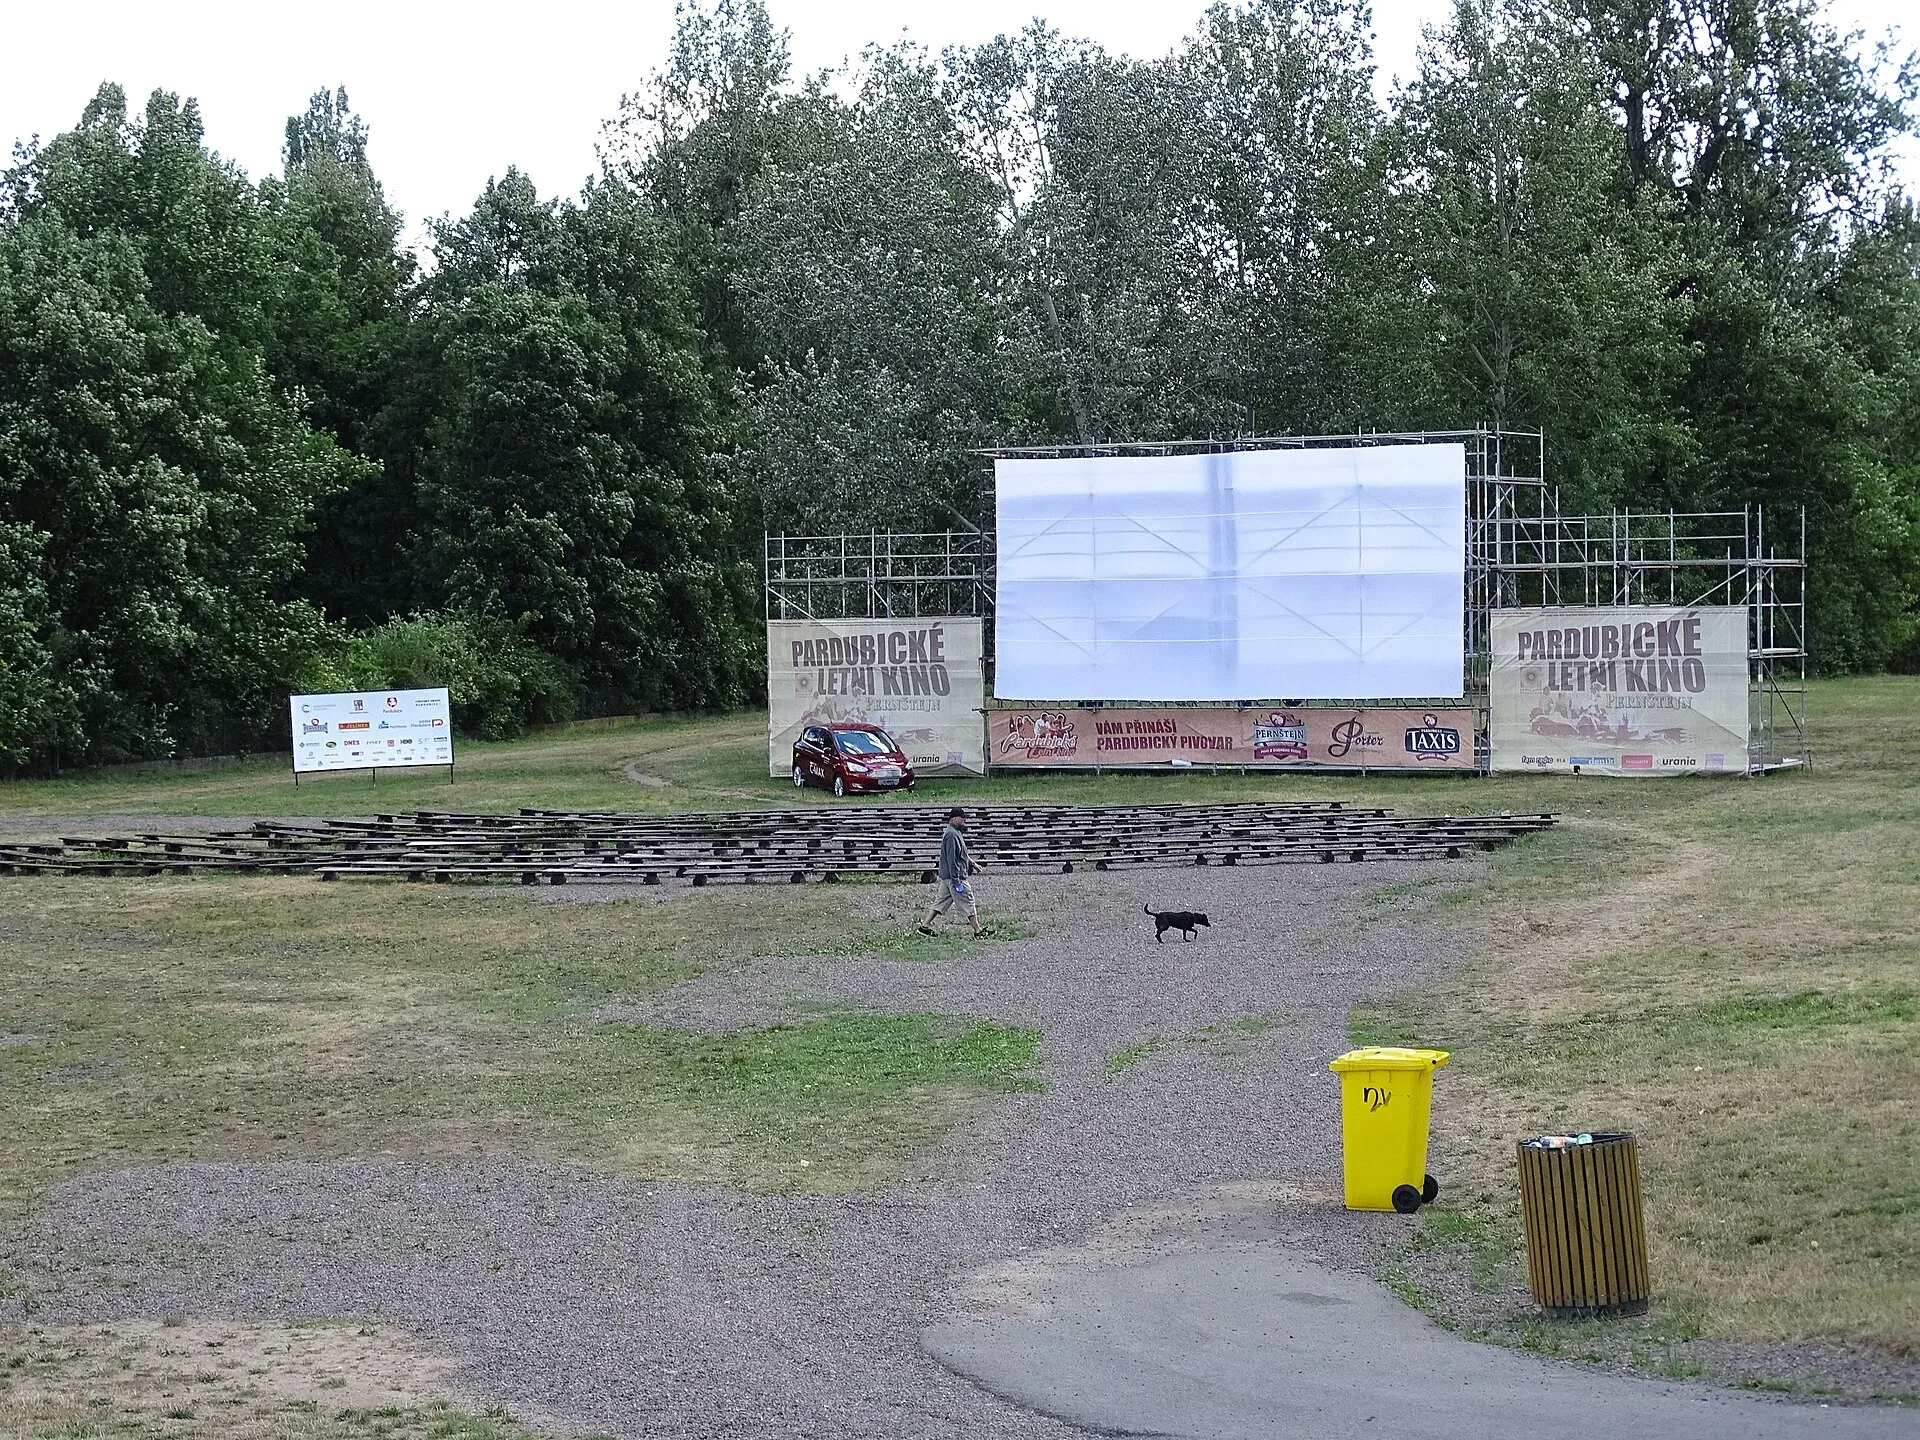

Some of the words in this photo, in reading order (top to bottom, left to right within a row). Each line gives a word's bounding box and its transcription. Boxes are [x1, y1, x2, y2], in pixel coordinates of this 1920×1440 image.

[792, 621, 945, 667] PARDUBICKÉ
[1518, 611, 1702, 661] PARDUBICKÉ
[881, 664, 950, 696] KINO
[1625, 658, 1706, 693] KINO
[1095, 720, 1123, 735] VÁM
[1255, 729, 1304, 740] PERNŠTEJN
[1328, 716, 1384, 757] Porter
[1097, 733, 1178, 750] PARDUBICKÝ
[1180, 736, 1233, 750] PIVOVAR
[1407, 730, 1456, 751] TAXIS
[913, 754, 940, 763] urania
[1662, 756, 1696, 766] urania
